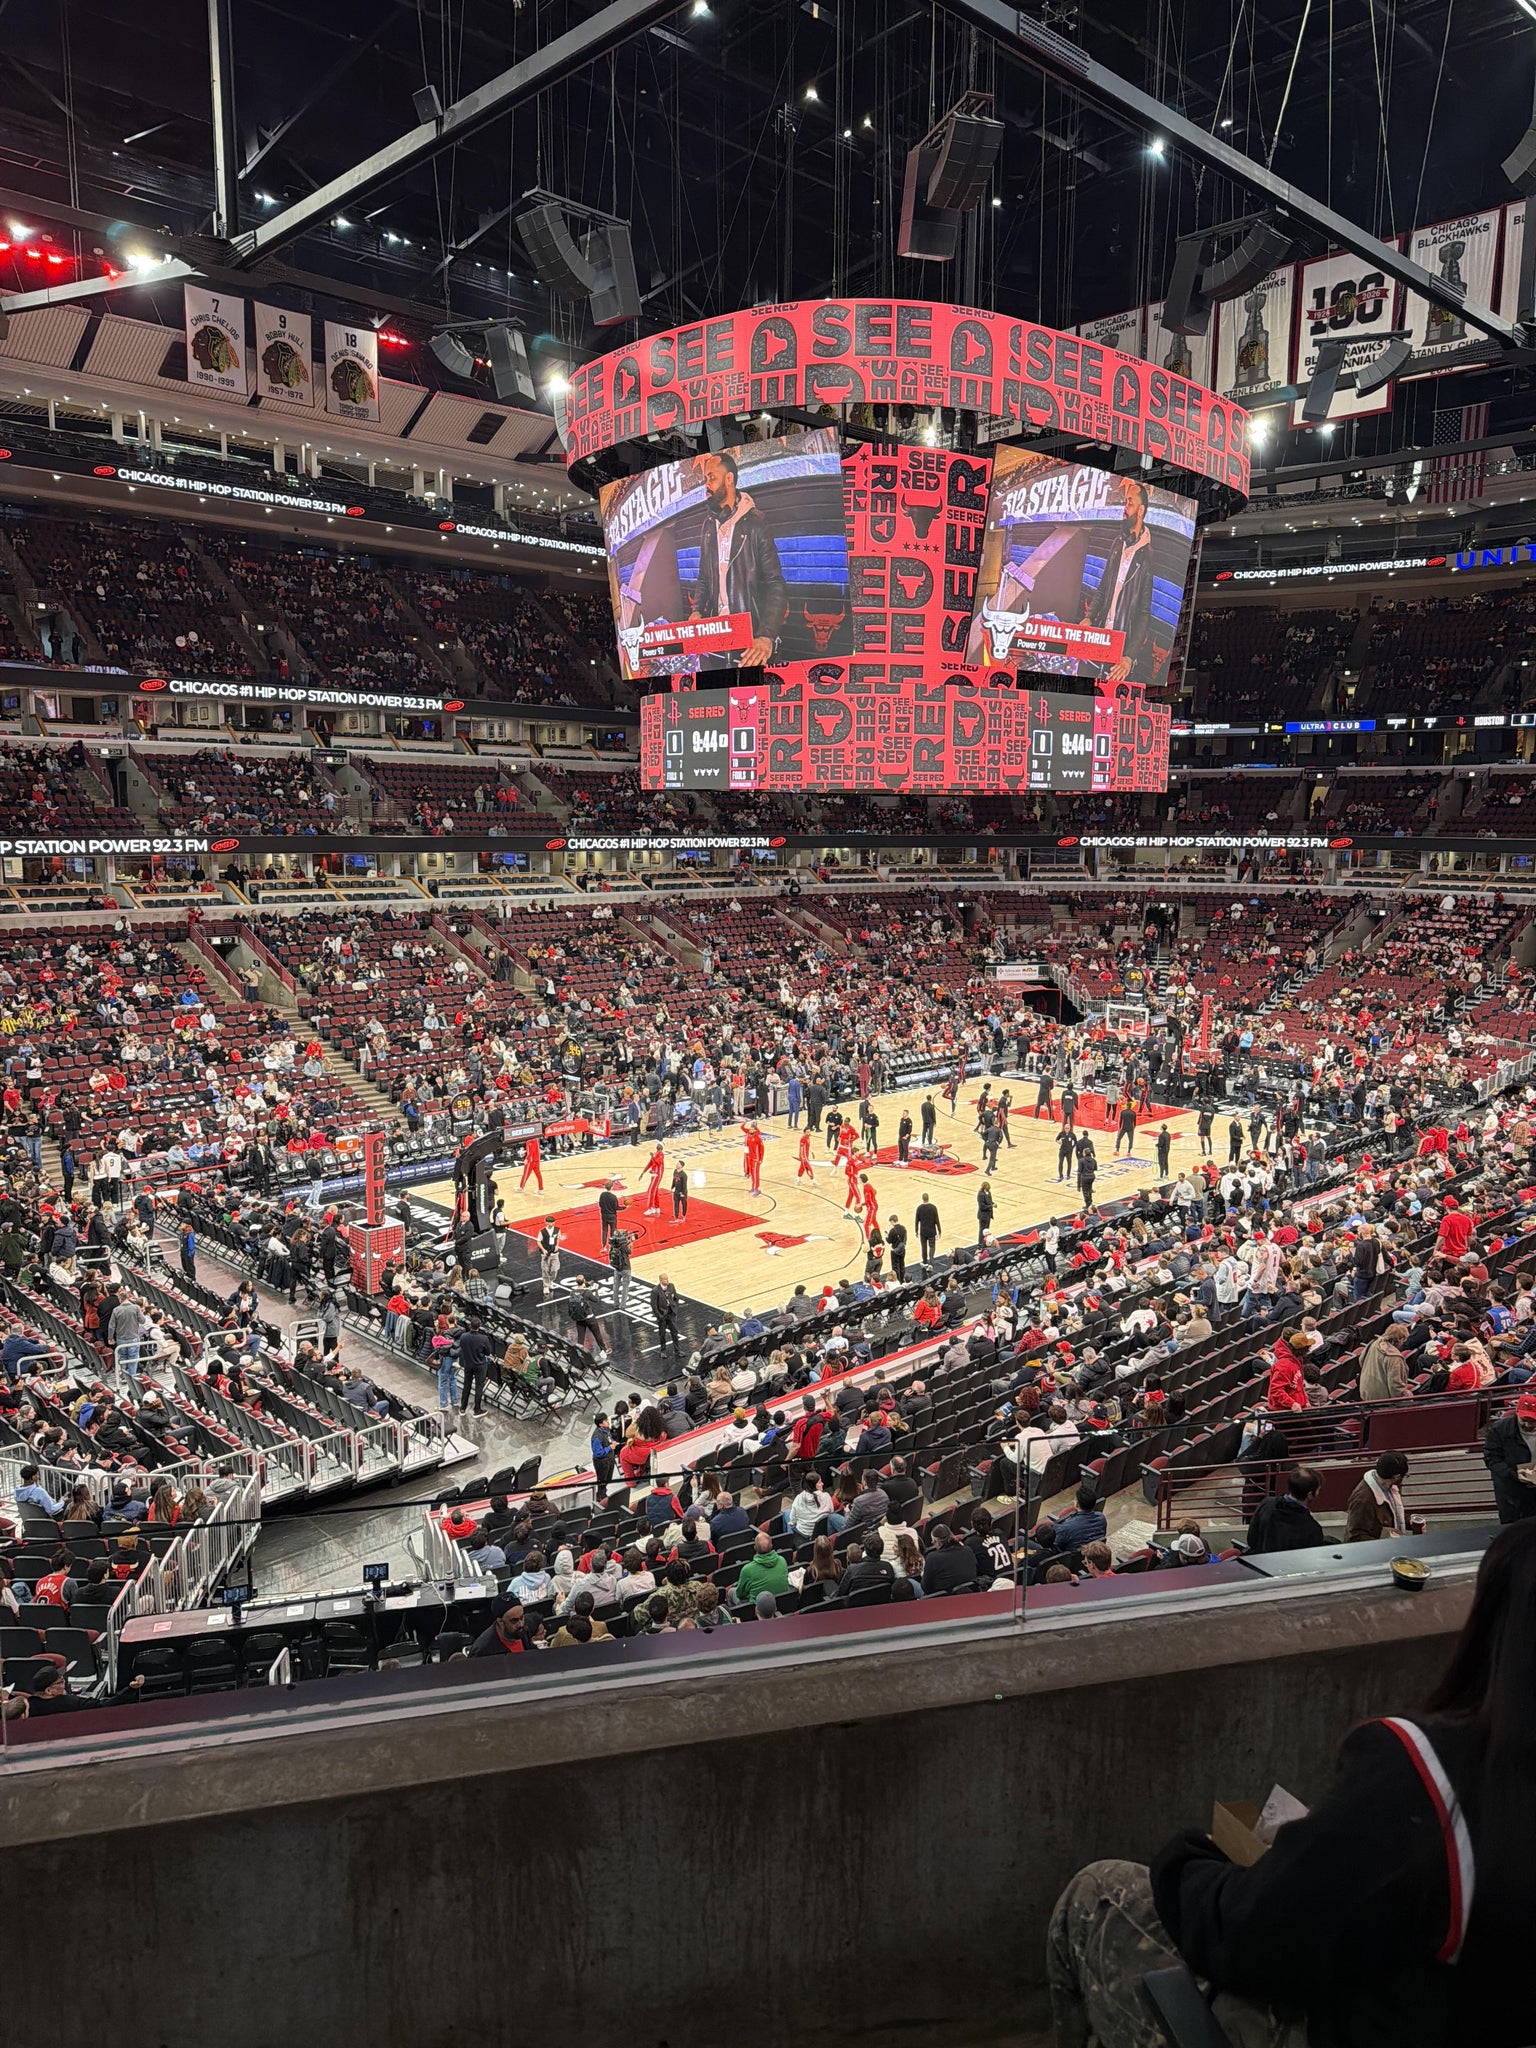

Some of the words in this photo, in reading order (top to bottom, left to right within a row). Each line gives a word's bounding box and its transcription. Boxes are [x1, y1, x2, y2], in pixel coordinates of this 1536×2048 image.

[1430, 216, 1478, 236] CHICAGO
[1418, 223, 1490, 249] BLACKHAWKS
[1362, 290, 1380, 299] 2026
[212, 298, 219, 313] 7
[1310, 272, 1385, 336] 100
[190, 313, 211, 327] CHRIS
[211, 315, 240, 341] CHELIOS
[279, 315, 287, 329] 9
[1085, 319, 1137, 340] BLACKHAWKS
[1094, 313, 1128, 330] CHICAGO
[265, 329, 288, 342] BOBBY
[288, 332, 304, 350] HULL
[812, 304, 932, 359] SEE
[345, 332, 357, 348] 18
[651, 318, 734, 387] SEE
[1410, 343, 1454, 360] STANLEY
[921, 364, 943, 376] SEE
[1026, 329, 1104, 397] SEE
[196, 371, 235, 387] 1990-1999
[725, 372, 745, 386] SEE
[268, 386, 304, 400] 1957-1972
[1223, 385, 1259, 399] STANLEY
[1263, 381, 1282, 391] CUP
[1094, 401, 1110, 414] SEE
[1150, 371, 1202, 434] SEE
[599, 410, 611, 423] SEE
[909, 451, 946, 473] SEE
[901, 472, 941, 491] RED
[118, 468, 174, 487] CHICAGOS
[175, 478, 187, 489] #1
[189, 480, 207, 492] HIP
[208, 483, 231, 496] HOP
[232, 487, 274, 503] STATION
[275, 493, 311, 509] POWER
[312, 498, 332, 512] 92.3
[332, 503, 346, 514] FM
[870, 464, 898, 544] RED
[947, 509, 965, 522] SEE
[966, 511, 985, 525] RED
[456, 523, 497, 539] CHICAGOS
[507, 532, 521, 542] HIP
[521, 534, 539, 545] HOP
[539, 538, 569, 550] STATION
[569, 542, 598, 555] POWER
[1233, 569, 1277, 580] CHICAGOS
[1277, 568, 1286, 577] #1
[1287, 567, 1302, 577] HIP
[1302, 566, 1323, 576] HOP
[1323, 563, 1358, 575] STATION
[1359, 561, 1393, 571] POWER
[1393, 559, 1411, 569] 92.3
[1412, 558, 1426, 568] FM
[644, 630, 655, 644] DJ
[655, 628, 674, 641] WILL
[675, 625, 694, 638] THE
[696, 621, 732, 636] THRILL
[1025, 622, 1038, 636] DJ
[1040, 624, 1062, 639] WILL
[1064, 628, 1082, 641] THE
[1083, 630, 1112, 646] THRILL
[642, 648, 656, 657] Power
[656, 647, 664, 655] 92
[1017, 641, 1037, 650] Power
[1037, 641, 1046, 651] 92
[169, 680, 239, 697] CHICAGOS
[239, 685, 254, 698] #1
[255, 686, 277, 699] HIP
[278, 687, 307, 701] HOP
[308, 689, 358, 705] STATION
[359, 693, 402, 708] POWER
[403, 696, 425, 709] 92.3
[425, 698, 443, 710] FM
[892, 697, 909, 706] SEE
[688, 706, 705, 719] SEE
[705, 705, 726, 717] RED
[1013, 703, 1025, 712] SEE
[1058, 709, 1075, 722] SEE
[1075, 711, 1091, 723] RED
[1474, 715, 1505, 726] HOUSTON
[1333, 722, 1360, 730] CLUB
[672, 734, 677, 753] 0
[692, 729, 718, 753] 9:44
[740, 731, 747, 750] 0
[882, 736, 912, 750] SEE
[1006, 739, 1026, 752] SEE
[1040, 734, 1045, 753] 0
[1061, 732, 1085, 756] 9:44
[1100, 738, 1106, 755] 0
[810, 749, 844, 766] SEE
[877, 750, 907, 764] RED
[953, 750, 979, 765] SEE
[1002, 752, 1023, 766] RED
[1136, 756, 1150, 771] SEE
[732, 770, 747, 780] FOULS
[769, 773, 785, 782] SEE
[785, 773, 803, 782] RED
[912, 773, 929, 782] SEE
[929, 773, 945, 782] RED
[15, 839, 86, 855] STATION
[89, 839, 151, 853] POWER
[152, 838, 183, 852] 92.3
[185, 838, 208, 852] FM
[567, 838, 619, 850] CHICAGOS
[619, 838, 630, 849] #1
[631, 838, 647, 849] HIP
[648, 838, 669, 849] HOP
[670, 837, 706, 849] STATION
[707, 837, 739, 848] POWER
[740, 837, 756, 848] 92.3
[756, 837, 769, 847] FM
[1079, 836, 1135, 847] CHICAGOS
[1135, 836, 1148, 847] #1
[1149, 836, 1167, 848] HIP
[1169, 836, 1194, 848] HOP
[1195, 836, 1241, 848] STATION
[1242, 837, 1286, 848] POWER
[1286, 837, 1309, 848] 92.3
[1310, 838, 1328, 848] FM
[471, 1247, 491, 1257] CREEK
[987, 1543, 1011, 1571] 28
